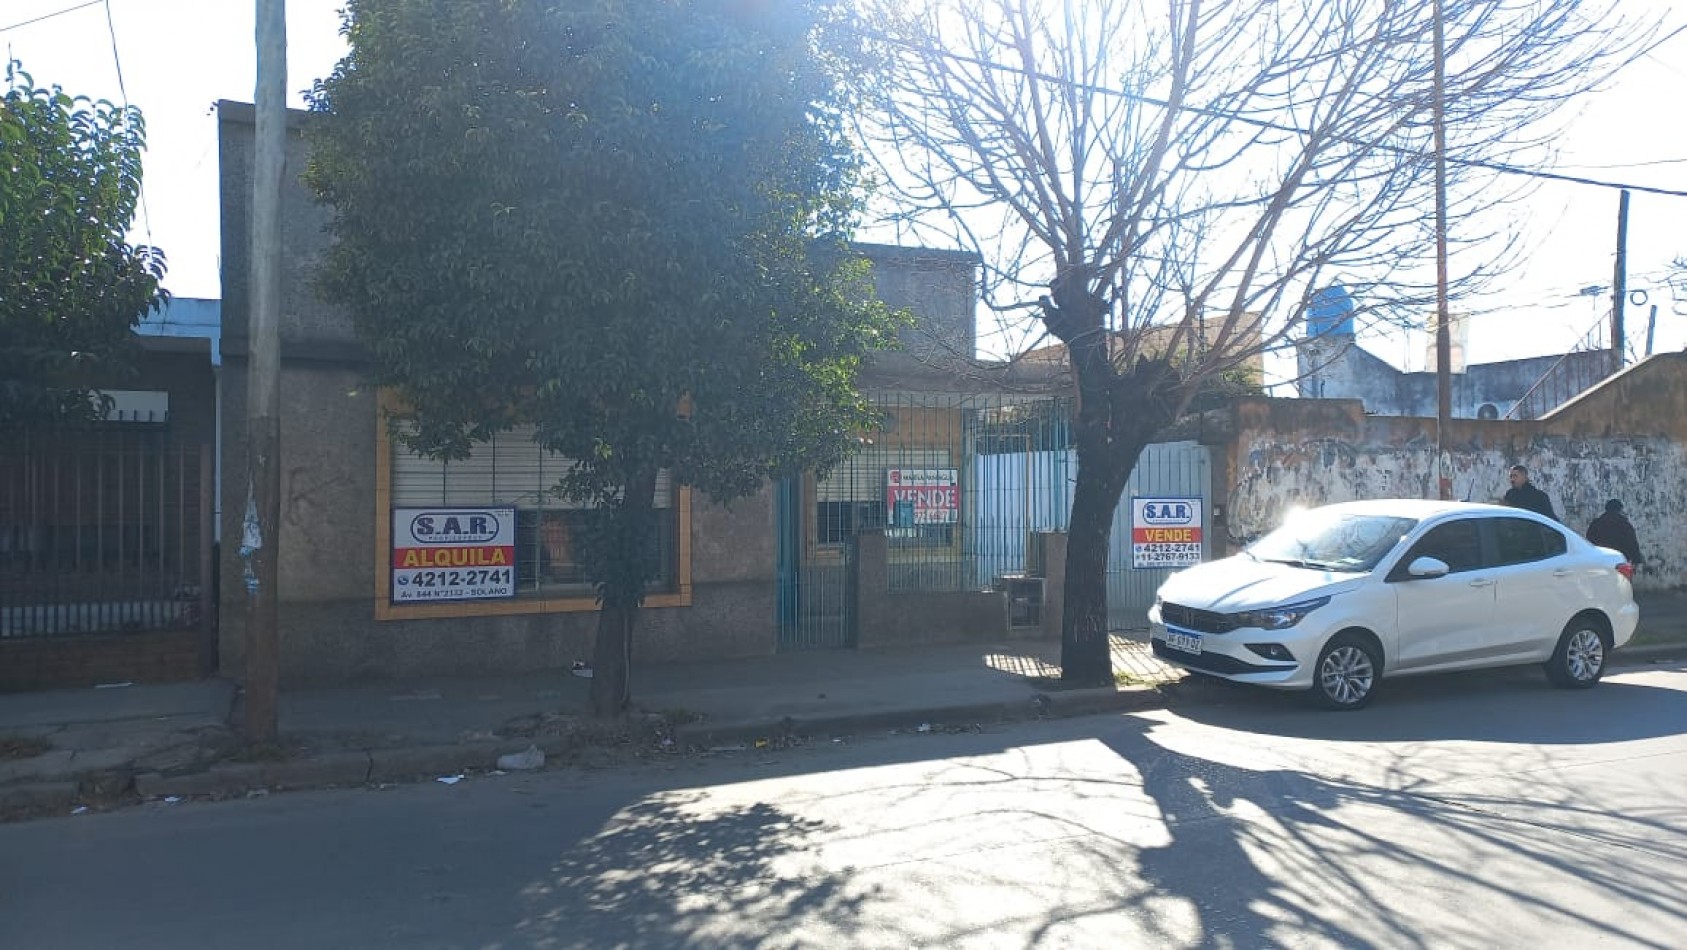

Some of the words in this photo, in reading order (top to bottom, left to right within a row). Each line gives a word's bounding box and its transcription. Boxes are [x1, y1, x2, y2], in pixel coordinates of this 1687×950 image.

[894, 489, 955, 507] VENDE
[1146, 504, 1190, 518] S.A.R.
[416, 517, 495, 535] S.A.R.
[1145, 529, 1192, 542] VENDE
[1143, 543, 1200, 552] 4212-2741
[403, 548, 506, 567] ALQUILA
[411, 568, 510, 587] 4212-2741
[470, 587, 508, 596] SOLANO
